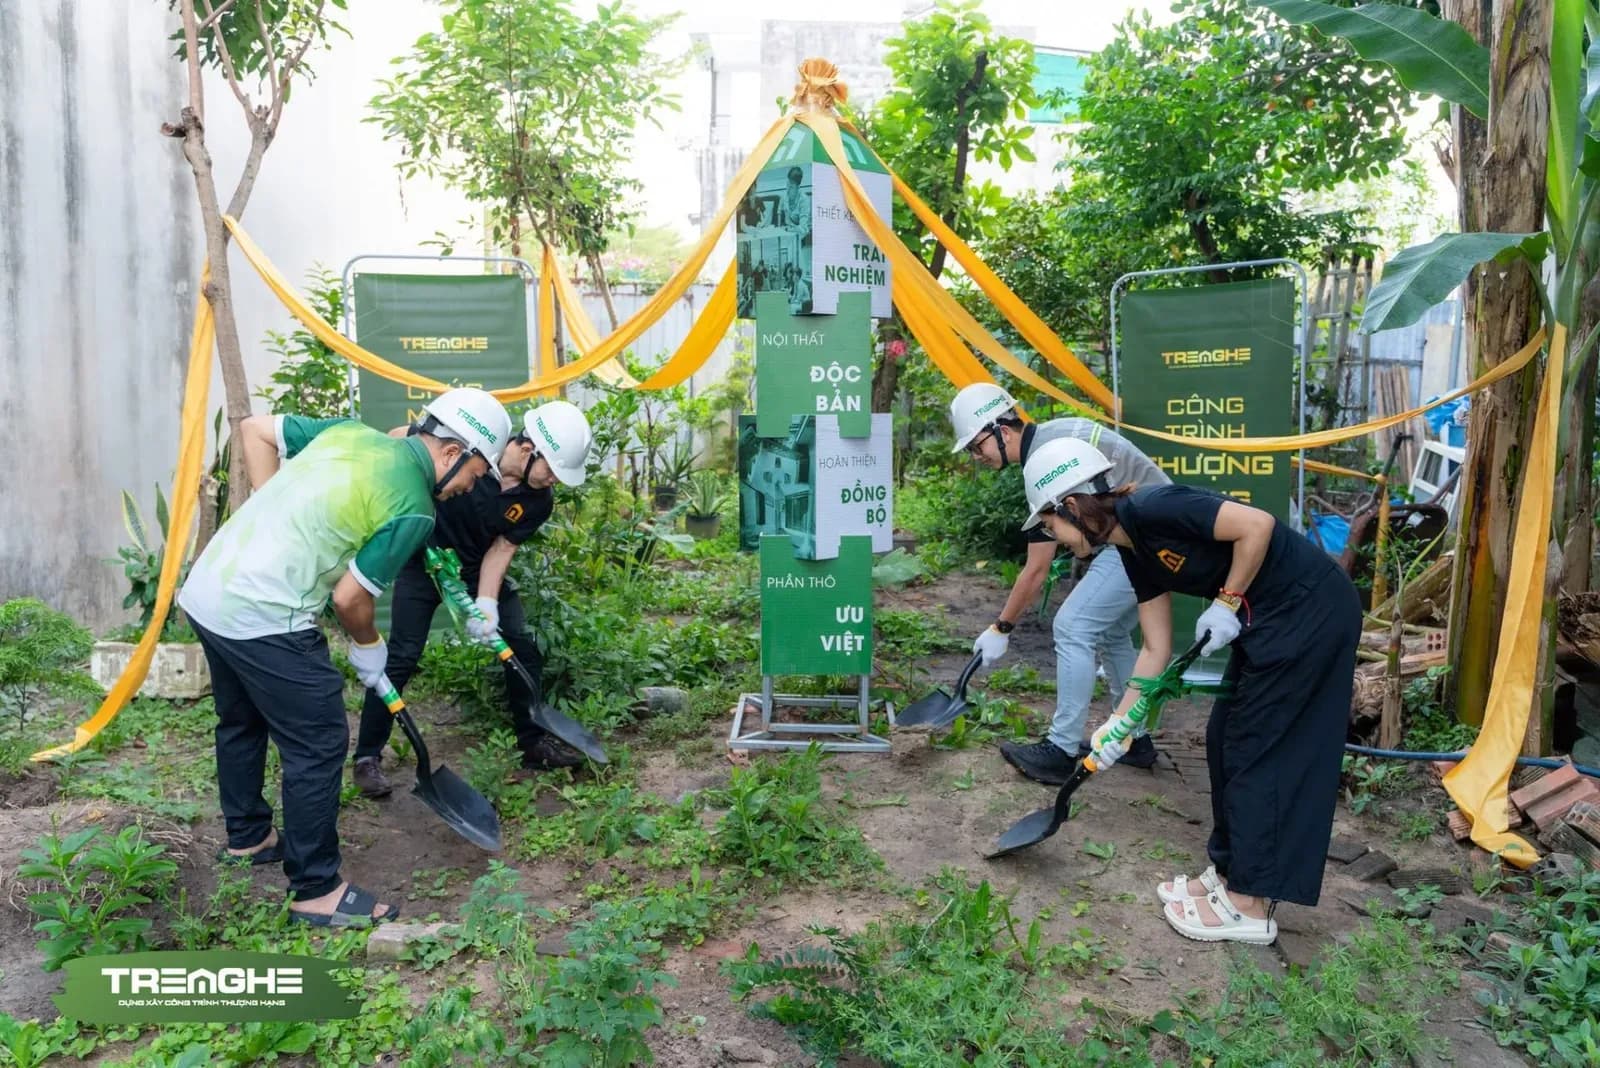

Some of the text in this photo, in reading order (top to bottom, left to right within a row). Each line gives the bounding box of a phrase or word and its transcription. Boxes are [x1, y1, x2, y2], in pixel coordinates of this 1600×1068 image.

[825, 264, 886, 289] NGHIỆM
[762, 330, 825, 348] NỘI THẤT
[810, 361, 861, 387] ĐỘC
[816, 389, 861, 412] BẢN
[1167, 393, 1244, 415] CÔNG
[1165, 419, 1245, 439] TRÌNH
[1150, 453, 1274, 481] HƯỢNG
[841, 479, 887, 504] ĐỒNG
[866, 504, 887, 527] BỘ
[808, 574, 836, 588] THÔ
[835, 604, 864, 623] ƯU
[820, 630, 865, 656] VIỆT
